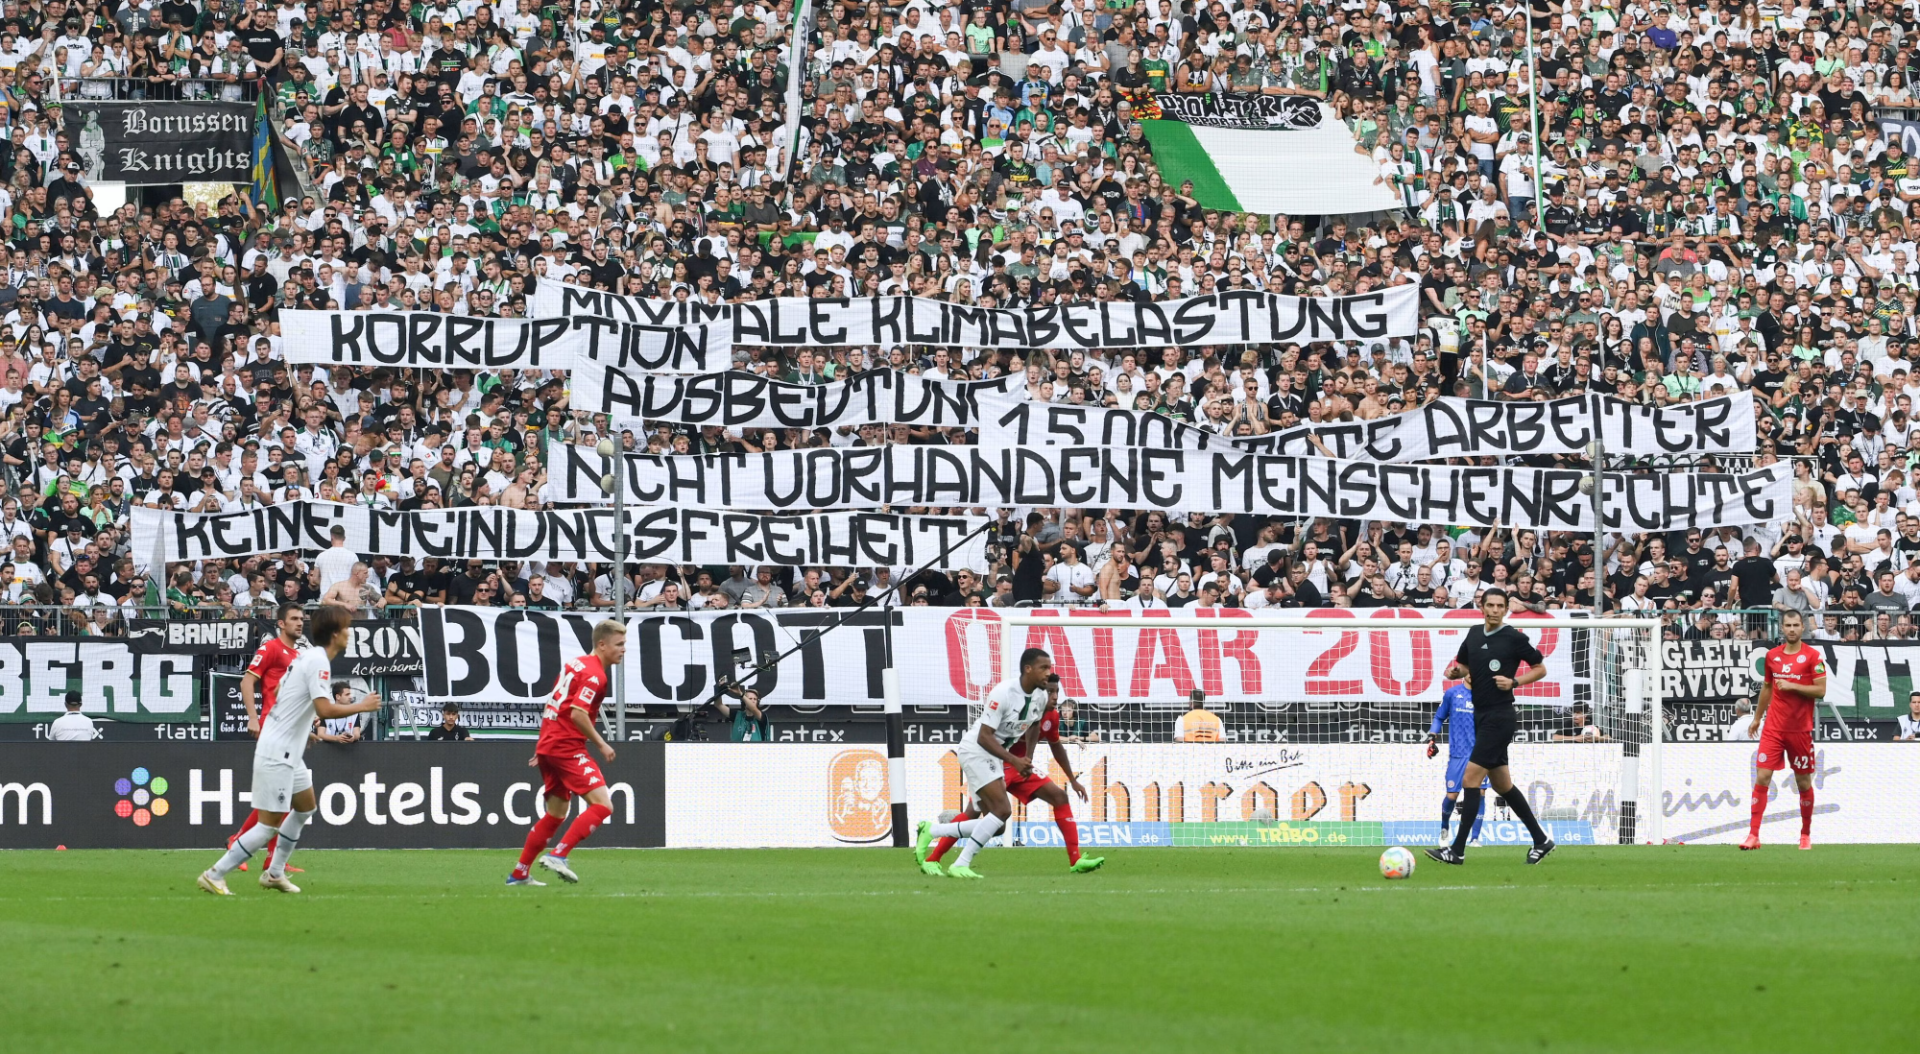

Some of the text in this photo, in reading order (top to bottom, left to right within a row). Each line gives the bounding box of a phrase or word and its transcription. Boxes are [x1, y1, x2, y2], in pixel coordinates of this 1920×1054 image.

[122, 108, 248, 138] Borussen
[118, 147, 251, 174] Knights
[873, 291, 1388, 346] KLIMABELASTUNG
[331, 313, 708, 370] KORRUPTION
[1424, 393, 1731, 453] ARBEITER
[764, 446, 1184, 508] VORHANDENE
[1211, 451, 1777, 530] MENSCHENRECHTE
[175, 501, 968, 570] KEINE MEINUNGSFREIHEIT
[168, 622, 249, 645] BANDA
[219, 639, 245, 650] SUD
[1793, 755, 1809, 770] 42
